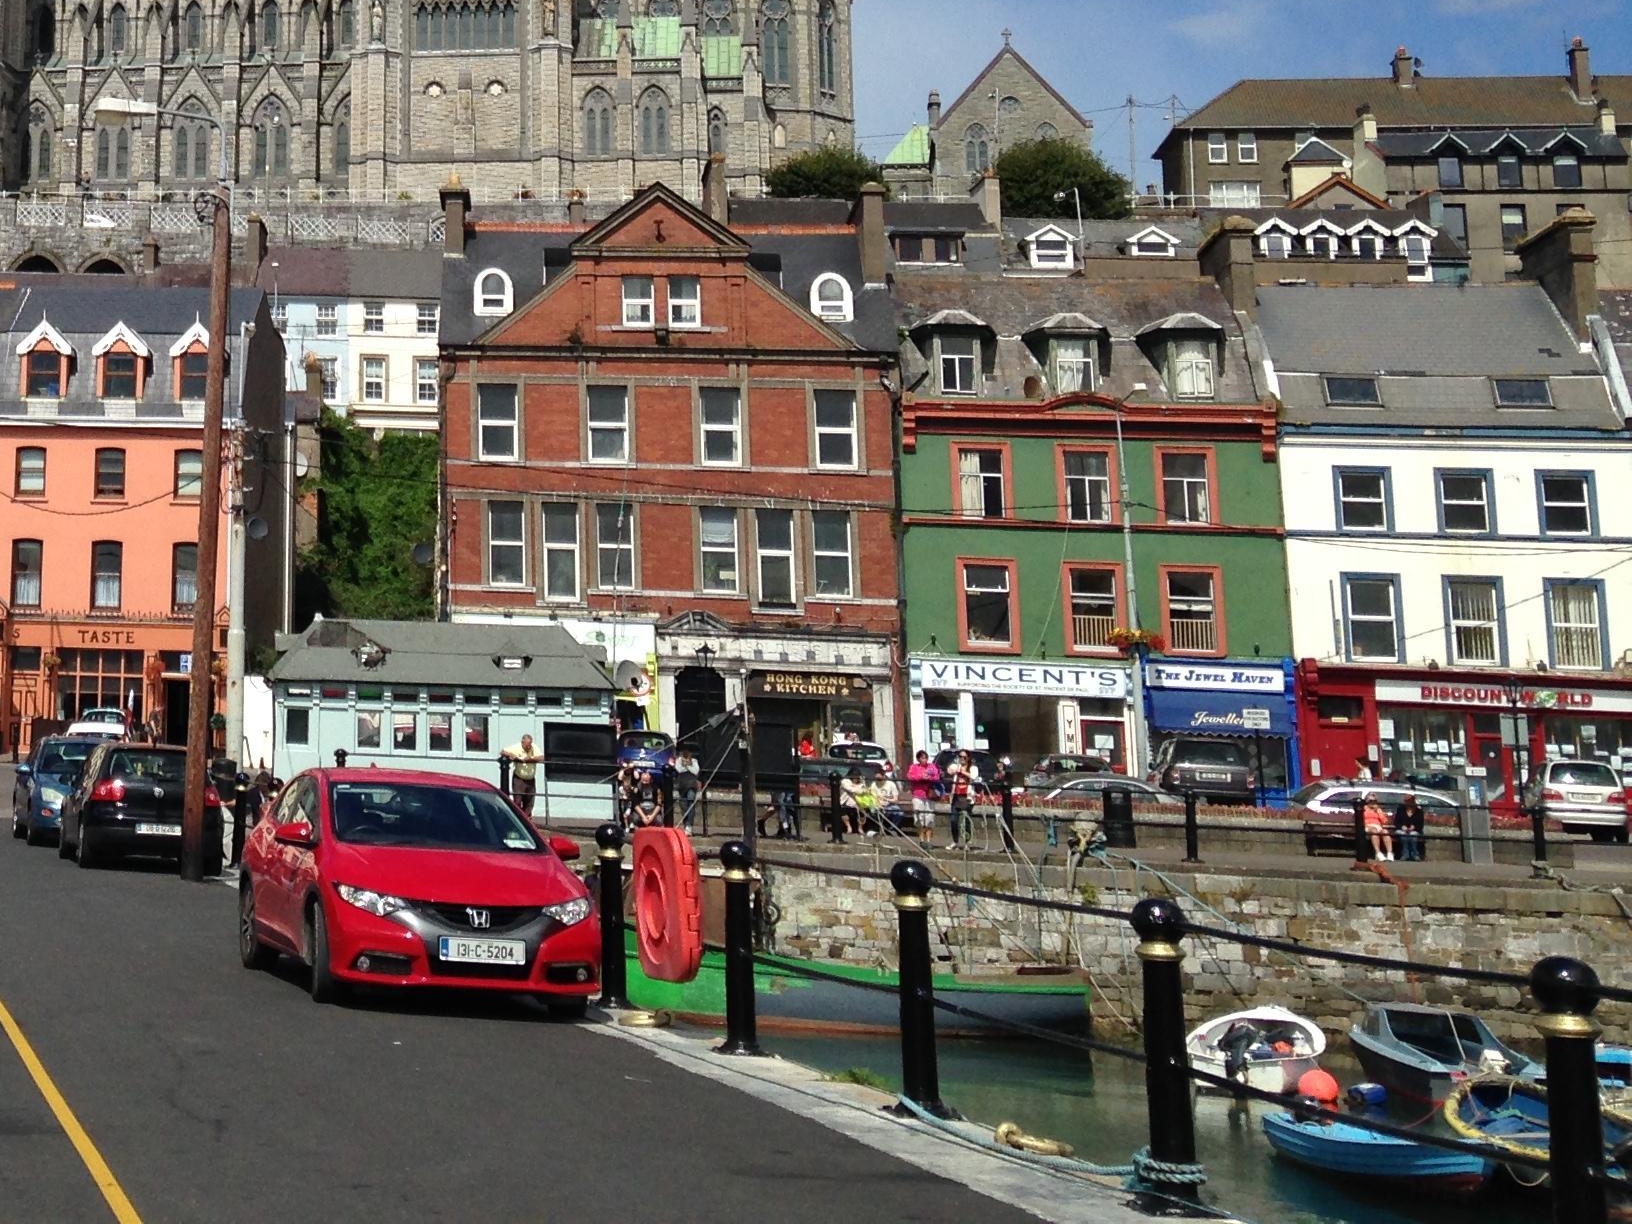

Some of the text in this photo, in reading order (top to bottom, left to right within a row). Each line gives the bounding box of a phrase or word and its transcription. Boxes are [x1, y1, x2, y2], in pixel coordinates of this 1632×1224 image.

[77, 629, 135, 645] TASTE
[766, 673, 847, 686] HONG KONG
[929, 663, 1118, 687] VINCENT'S
[1154, 669, 1274, 684] THE JEWEL HAVEN
[775, 682, 836, 696] KITCHEN
[1191, 711, 1245, 726] Jeweller
[457, 943, 514, 960] 131-C-5204
